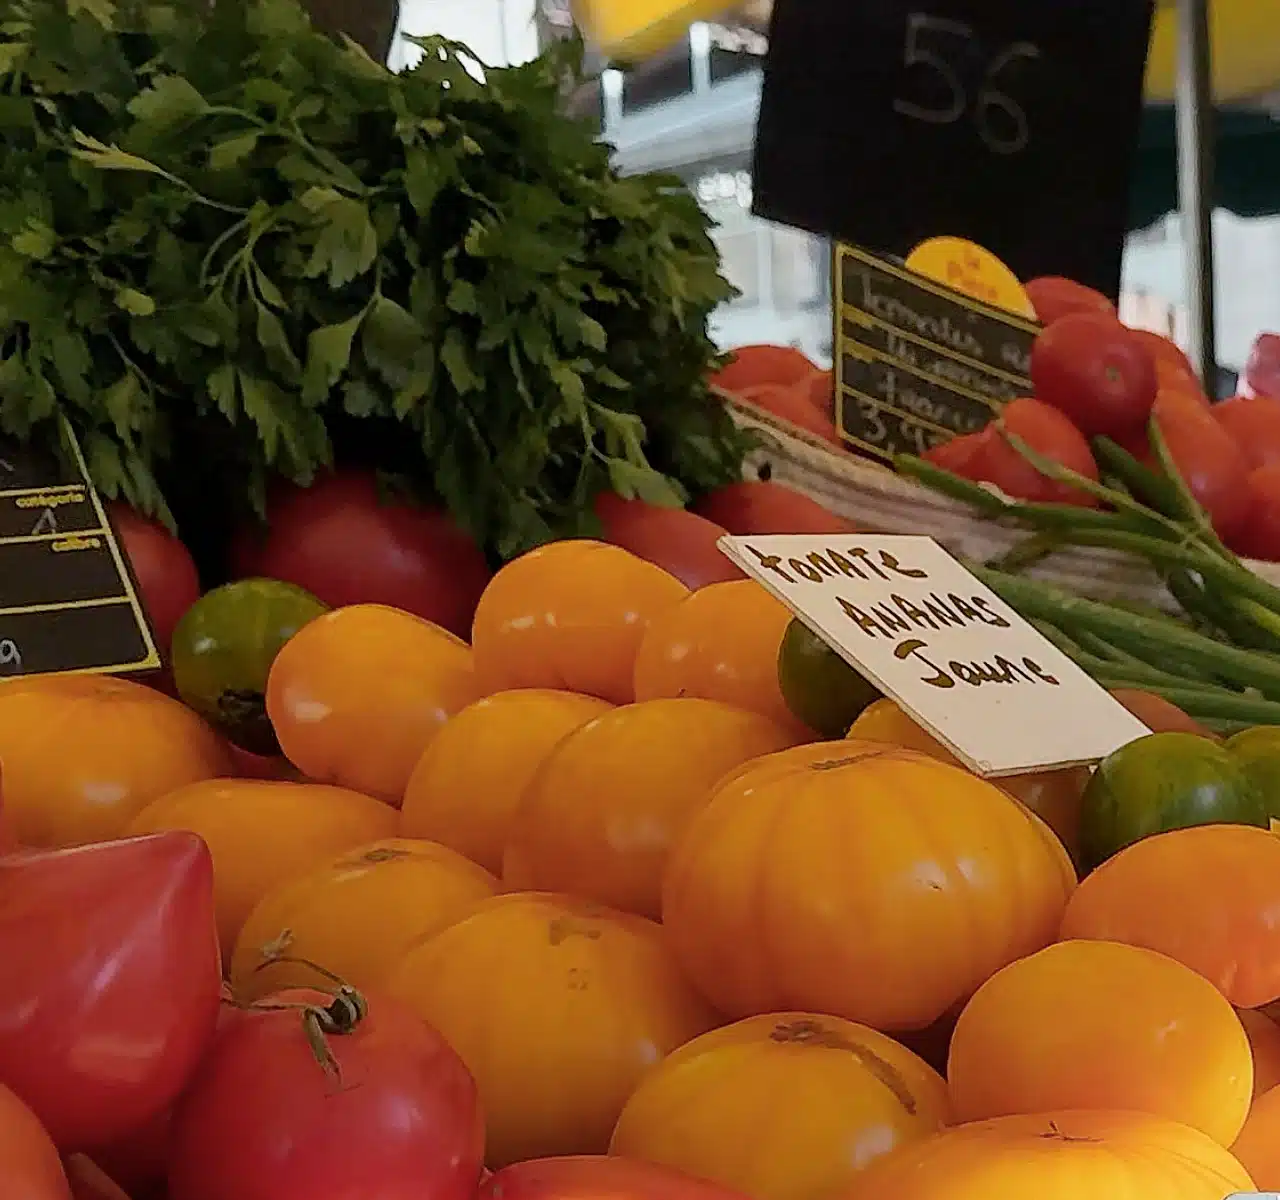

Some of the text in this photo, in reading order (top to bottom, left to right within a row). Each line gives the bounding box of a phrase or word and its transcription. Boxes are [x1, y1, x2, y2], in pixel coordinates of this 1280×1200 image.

[892, 13, 1040, 154] 56
[835, 592, 1011, 640] ANANAS
[893, 638, 1060, 689] Jaune
